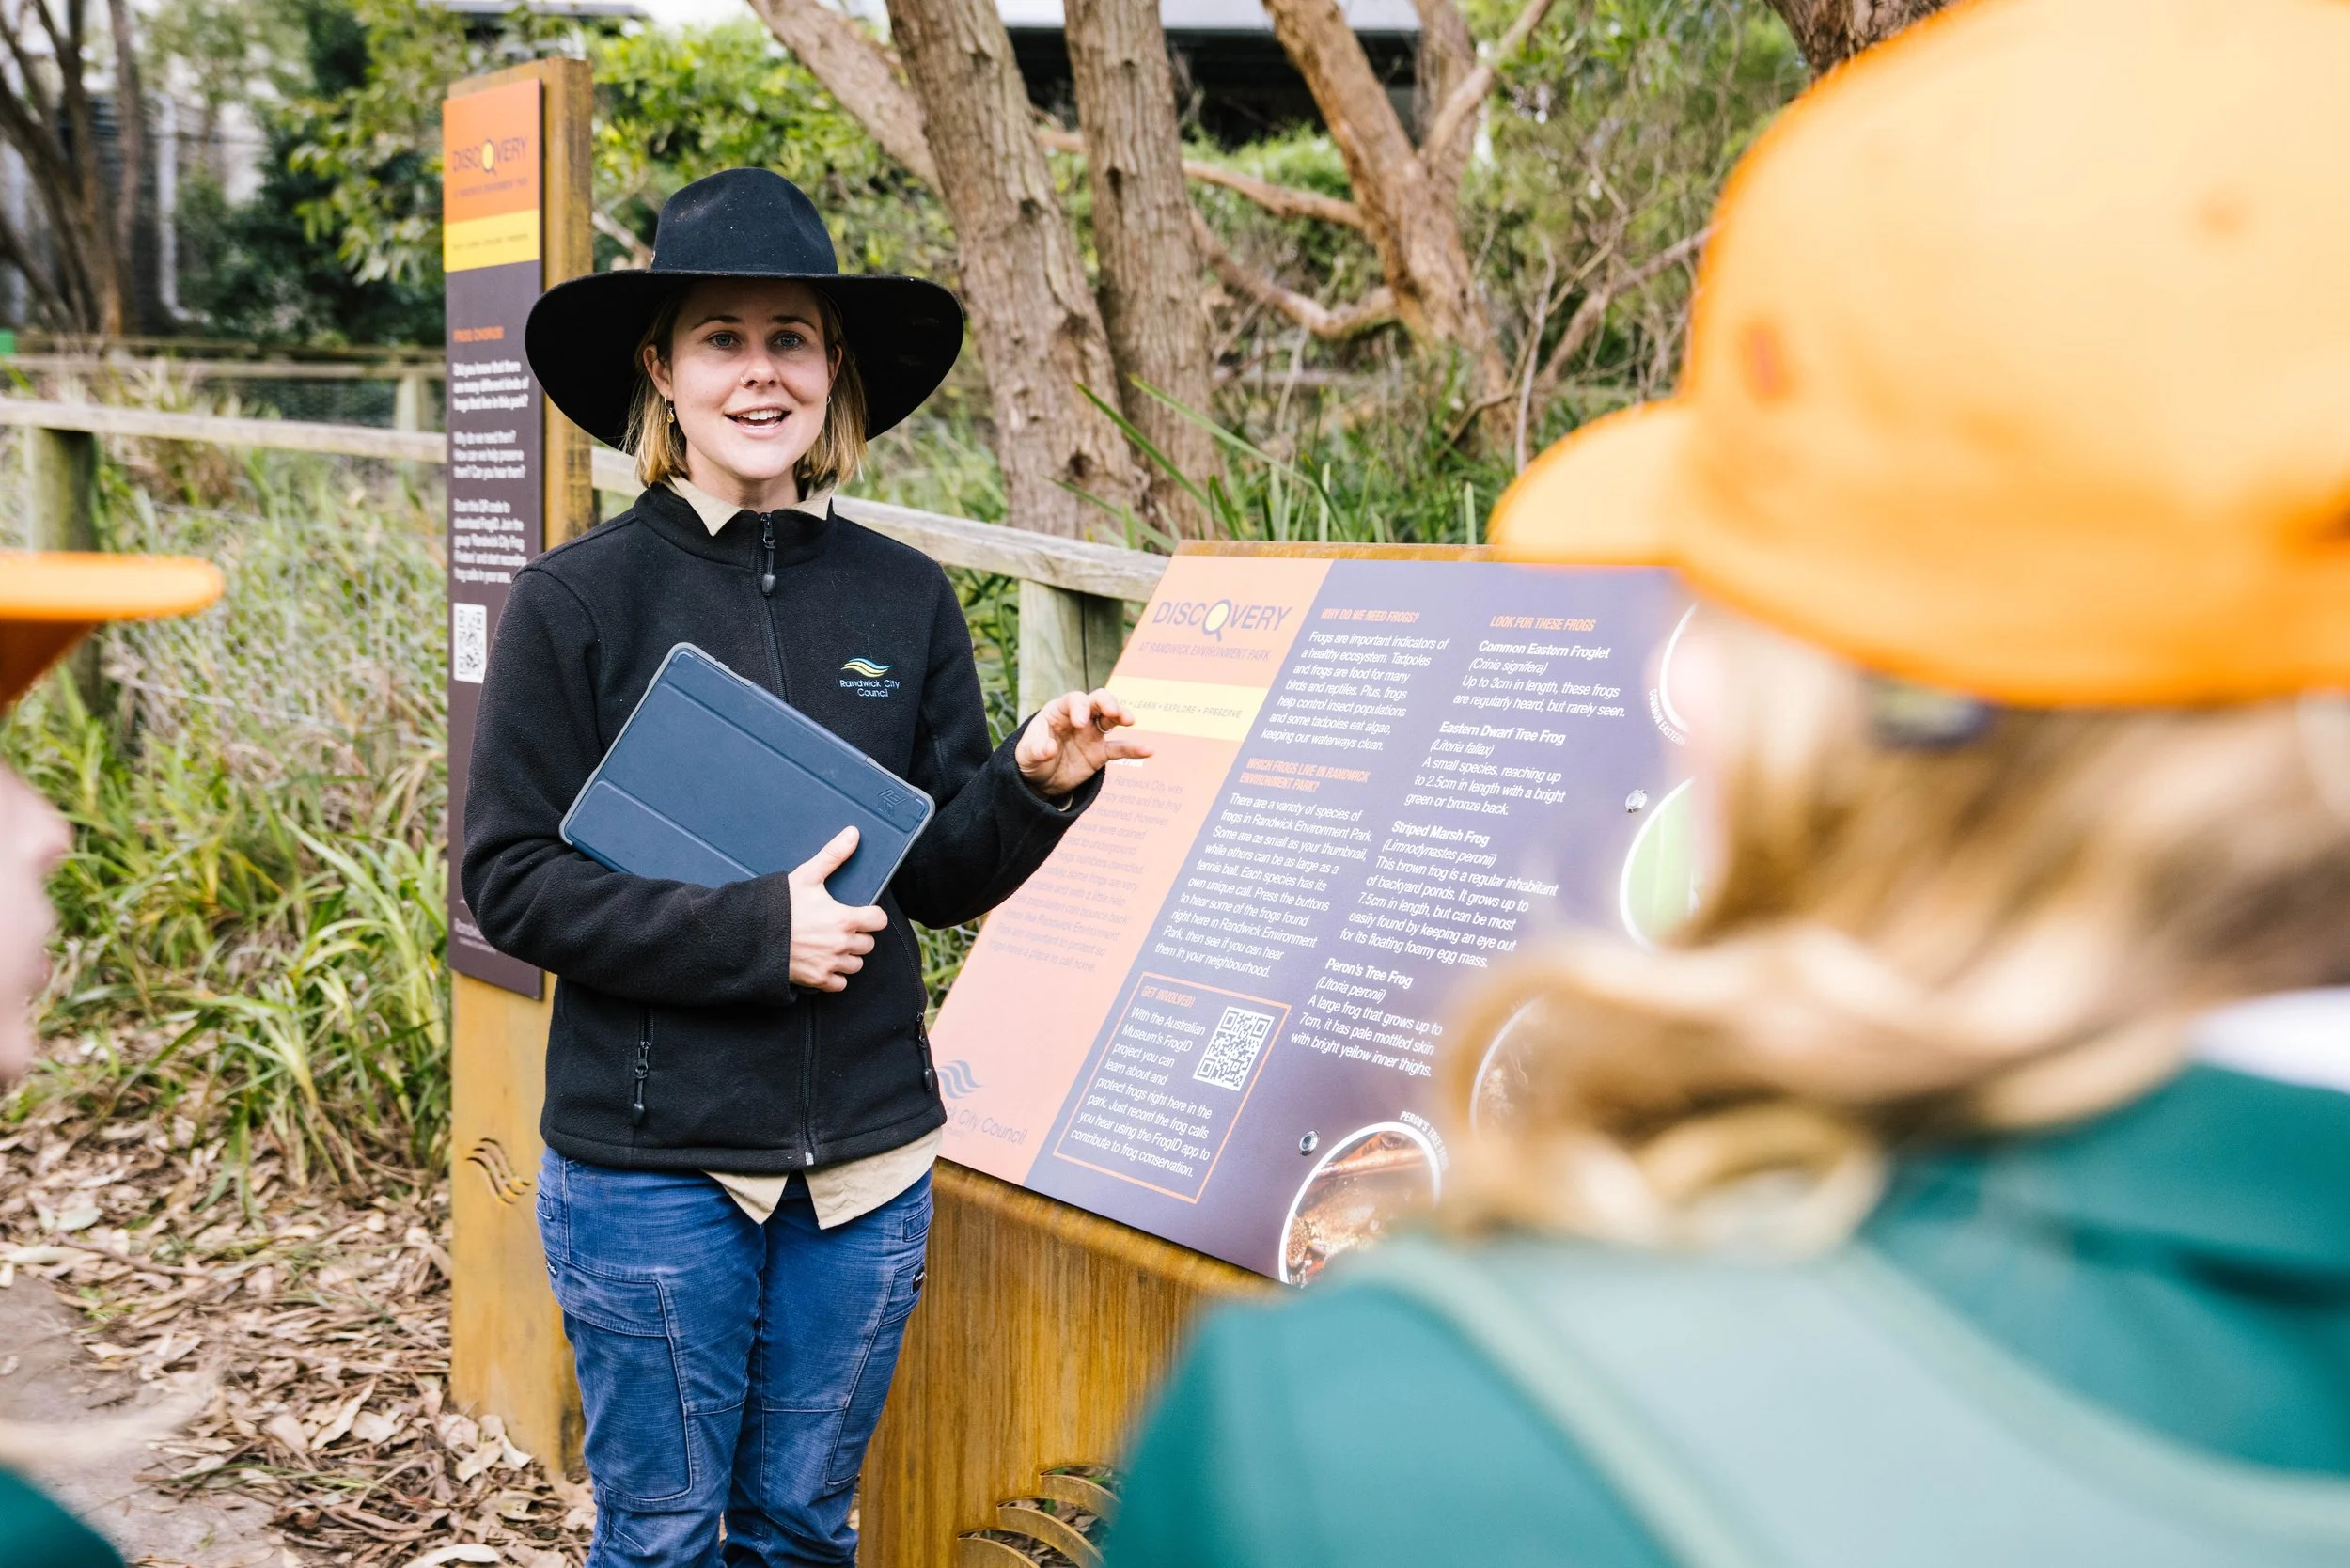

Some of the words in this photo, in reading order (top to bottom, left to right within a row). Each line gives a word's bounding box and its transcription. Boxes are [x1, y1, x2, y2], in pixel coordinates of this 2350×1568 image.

[1152, 598, 1293, 642] DISCOVERY
[1321, 608, 1341, 619] WHY
[1339, 608, 1353, 619] DO
[1352, 609, 1366, 620] WE
[1365, 610, 1387, 621] NEED
[1386, 611, 1419, 622] FROGS?
[1490, 616, 1516, 627] LOOK
[1514, 616, 1534, 628] FOR
[1534, 618, 1565, 630] THESE
[1563, 619, 1596, 631] FROGS
[1308, 631, 1335, 645] Frogs
[1333, 635, 1349, 644] are
[1348, 633, 1392, 647] important
[1391, 635, 1436, 649] indicators
[1436, 637, 1450, 650] of
[1479, 639, 1526, 653] Common
[1526, 642, 1569, 656] Eastern
[1569, 645, 1611, 661] Froglet
[1300, 649, 1308, 658] a
[1308, 647, 1340, 662] healthy
[1340, 651, 1387, 665] ecosystem.
[1391, 652, 1432, 666] Tadpoles
[1468, 657, 1501, 671] (Crinia
[1501, 660, 1549, 676] signifera)
[839, 680, 881, 688] Randwick
[884, 679, 900, 689] City
[1292, 664, 1312, 674] and
[1310, 664, 1333, 679] frogs
[1333, 668, 1348, 677] are
[1348, 666, 1371, 679] food
[1370, 667, 1385, 680] for
[1384, 671, 1411, 684] many
[1462, 674, 1477, 689] Up
[1478, 676, 1489, 688] to
[1490, 677, 1512, 689] 3cm
[1512, 678, 1524, 690] in
[1525, 679, 1558, 695] length,
[1561, 682, 1591, 695] these
[1591, 683, 1621, 699] frogs
[857, 688, 888, 698] Council
[1285, 679, 1308, 691] birds
[1307, 682, 1326, 693] and
[1324, 683, 1357, 696] reptiles.
[1359, 684, 1381, 698] Plus,
[1383, 686, 1408, 702] frogs
[1277, 695, 1296, 709] help
[1296, 698, 1328, 710] control
[1326, 699, 1355, 713] insect
[1352, 703, 1407, 717] populations
[1649, 688, 1664, 725] COMMON
[1269, 713, 1288, 723] and
[1286, 714, 1310, 726] some
[1310, 715, 1349, 729] tadpoles
[1349, 720, 1366, 730] eat
[1364, 720, 1391, 735] algae,
[1439, 721, 1480, 735] Eastern
[1480, 724, 1515, 739] Dwarf
[1514, 727, 1539, 741] Tree
[1538, 729, 1566, 746] Frog
[1261, 728, 1295, 744] keeping
[1294, 733, 1311, 743] our
[1310, 734, 1357, 749] waterways
[1357, 737, 1383, 751] clean.
[1429, 738, 1465, 753] (Litoria
[1464, 742, 1495, 759] fallax)
[1239, 772, 1294, 788] ENVIRONMENT
[1293, 778, 1320, 792] PARK?
[1246, 758, 1274, 770] WHICH
[1275, 760, 1298, 774] FROGS
[1297, 763, 1317, 776] LIVE
[1315, 766, 1327, 777] IN
[1324, 767, 1371, 783] RANDWICK
[1421, 756, 1432, 768] A
[1432, 759, 1460, 771] small
[1458, 762, 1497, 776] species,
[1500, 766, 1546, 783] reaching
[1545, 772, 1562, 785] up
[1220, 808, 1243, 824] frogs
[1242, 812, 1252, 823] in
[1251, 813, 1294, 830] Randwick
[1293, 820, 1350, 839] Environment
[1349, 827, 1372, 842] Park.
[1391, 820, 1431, 837] Striped
[1429, 825, 1464, 841] Marsh
[1463, 830, 1490, 848] Frog
[1381, 838, 1458, 860] (Limnodynastes
[1454, 852, 1497, 869] peronii)
[1196, 859, 1222, 873] tennis
[1221, 863, 1239, 876] ball.
[1240, 866, 1262, 880] Each
[1262, 872, 1297, 886] species
[1296, 875, 1315, 889] has
[1314, 878, 1327, 891] its
[1375, 855, 1396, 870] This
[1395, 859, 1427, 874] brown
[1427, 864, 1449, 881] frog
[1448, 868, 1459, 880] is
[1459, 871, 1468, 882] a
[1467, 873, 1506, 887] regular
[1504, 876, 1559, 896] inhabitant
[1154, 942, 1177, 956] them
[1175, 947, 1185, 958] in
[1183, 950, 1206, 963] your
[1204, 954, 1271, 978] neighbourhood.
[1324, 957, 1364, 976] Peron's
[1365, 964, 1387, 981] Tree
[1386, 970, 1414, 990] Frog
[1141, 985, 1157, 997] GET
[1155, 989, 1196, 1007] INVOLVED!
[1315, 976, 1349, 994] (Litoria
[1346, 985, 1386, 1004] peronii)
[1131, 1006, 1150, 1021] With
[1149, 1012, 1165, 1026] the
[1163, 1015, 1206, 1036] Australian
[1299, 1011, 1321, 1030] 7cm,
[1323, 1017, 1333, 1030] it
[1331, 1019, 1351, 1035] has
[1349, 1027, 1373, 1041] pale
[1372, 1032, 1414, 1050] mottled
[1412, 1040, 1434, 1055] skin
[1121, 1023, 1164, 1044] Museum's
[1162, 1034, 1193, 1053] FrogID
[1291, 1032, 1310, 1046] with
[1310, 1035, 1340, 1054] bright
[1338, 1044, 1372, 1061] yellow
[1371, 1050, 1399, 1067] inner
[1398, 1058, 1431, 1076] thighs.
[1400, 1110, 1430, 1132] PERON'S
[1070, 1129, 1111, 1150] contribute
[1110, 1140, 1120, 1152] to
[1120, 1142, 1139, 1161] frog
[1138, 1152, 1193, 1178] conservation.
